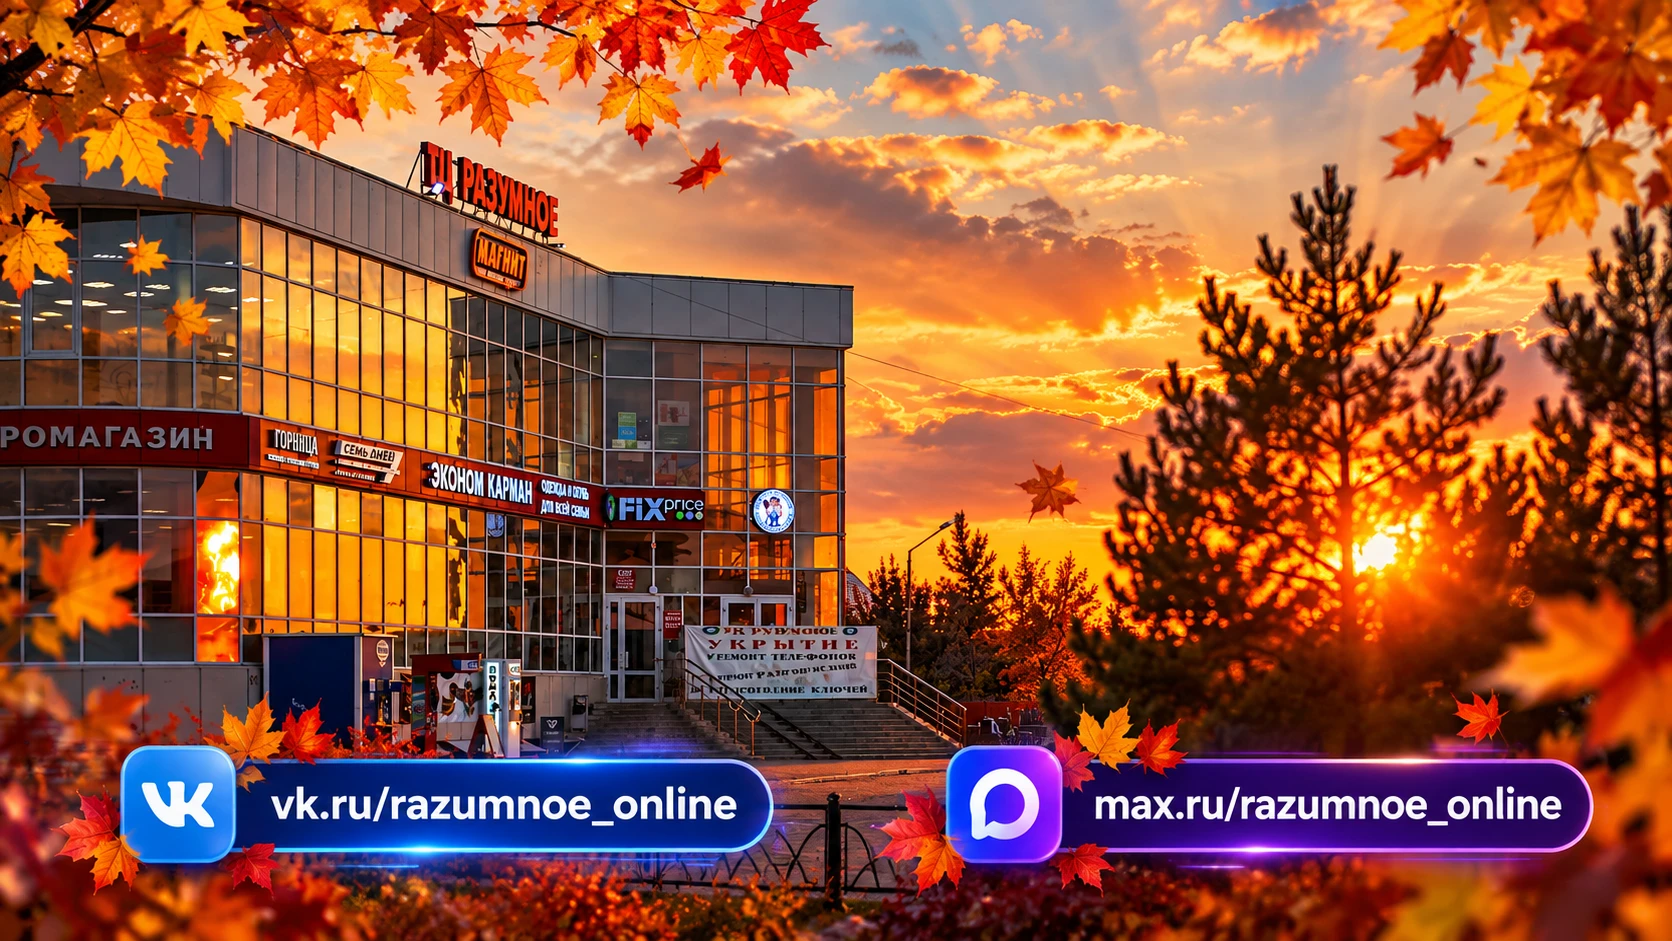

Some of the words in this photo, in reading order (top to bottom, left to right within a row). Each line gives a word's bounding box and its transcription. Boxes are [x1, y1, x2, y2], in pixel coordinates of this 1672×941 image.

[421, 142, 453, 205] ТЦ
[457, 157, 558, 237] РАЗУМНОЕ
[477, 238, 526, 280] МАГНИТ
[0, 426, 213, 450] РОМАГАЗИН
[274, 429, 318, 456] ГОРНИЦА
[344, 443, 368, 458] СЕМЬ
[430, 461, 484, 497] ЭКОНОМ
[488, 473, 533, 505] КАРМАН
[541, 479, 567, 498] ОДЕЖДА
[664, 499, 704, 513] price
[708, 639, 859, 650] УКРЫТИЕ
[811, 684, 868, 694] КЛЮЧЕЙ
